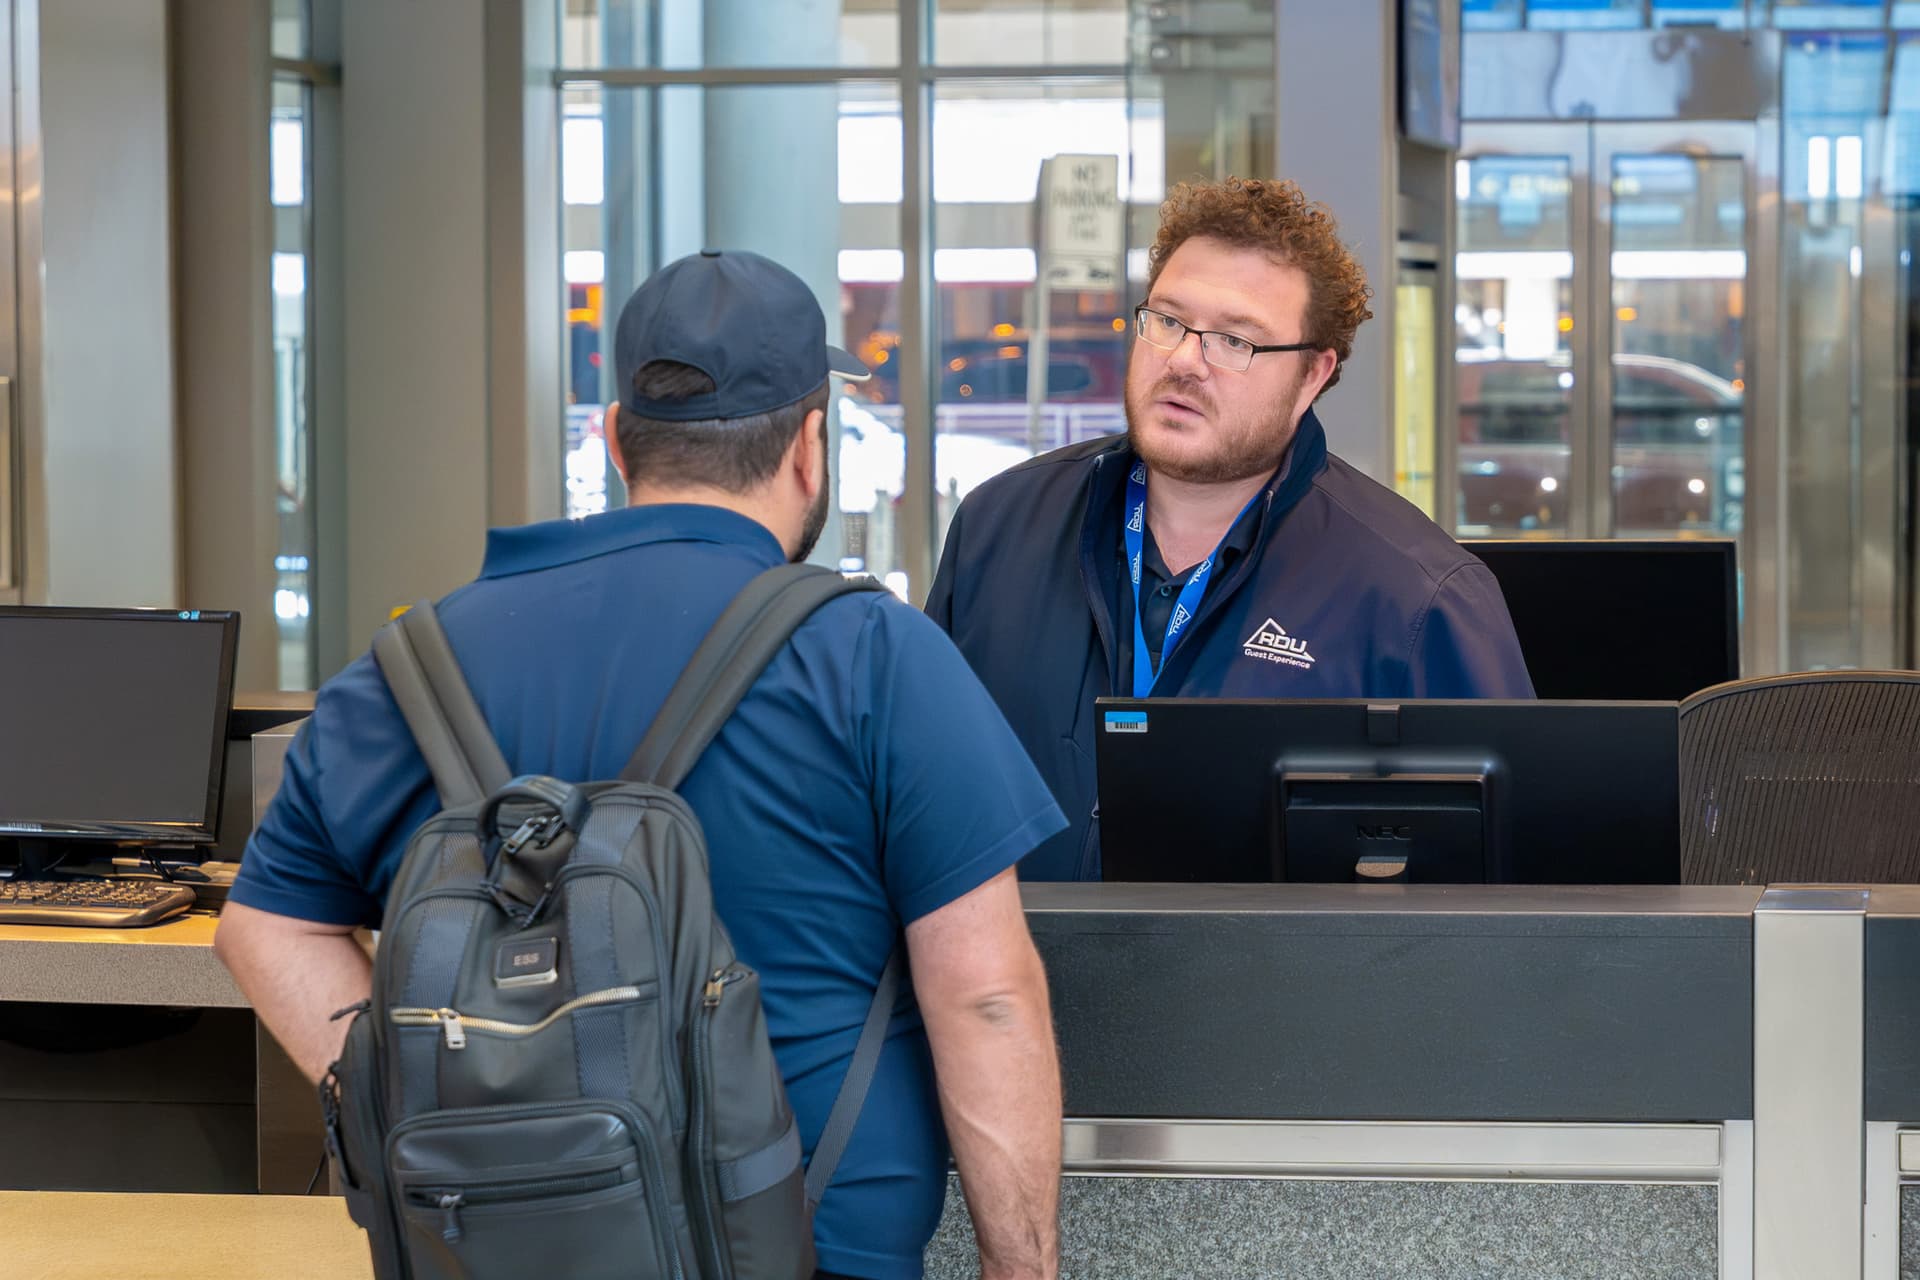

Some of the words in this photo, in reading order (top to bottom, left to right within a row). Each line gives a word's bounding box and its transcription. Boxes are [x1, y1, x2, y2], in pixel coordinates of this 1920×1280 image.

[1133, 507, 1141, 529] RDU
[1172, 609, 1186, 634] RDU
[1258, 631, 1307, 653] RDU
[1244, 648, 1267, 659] Guest
[1268, 653, 1311, 669] Experience
[1356, 824, 1412, 840] NEC
